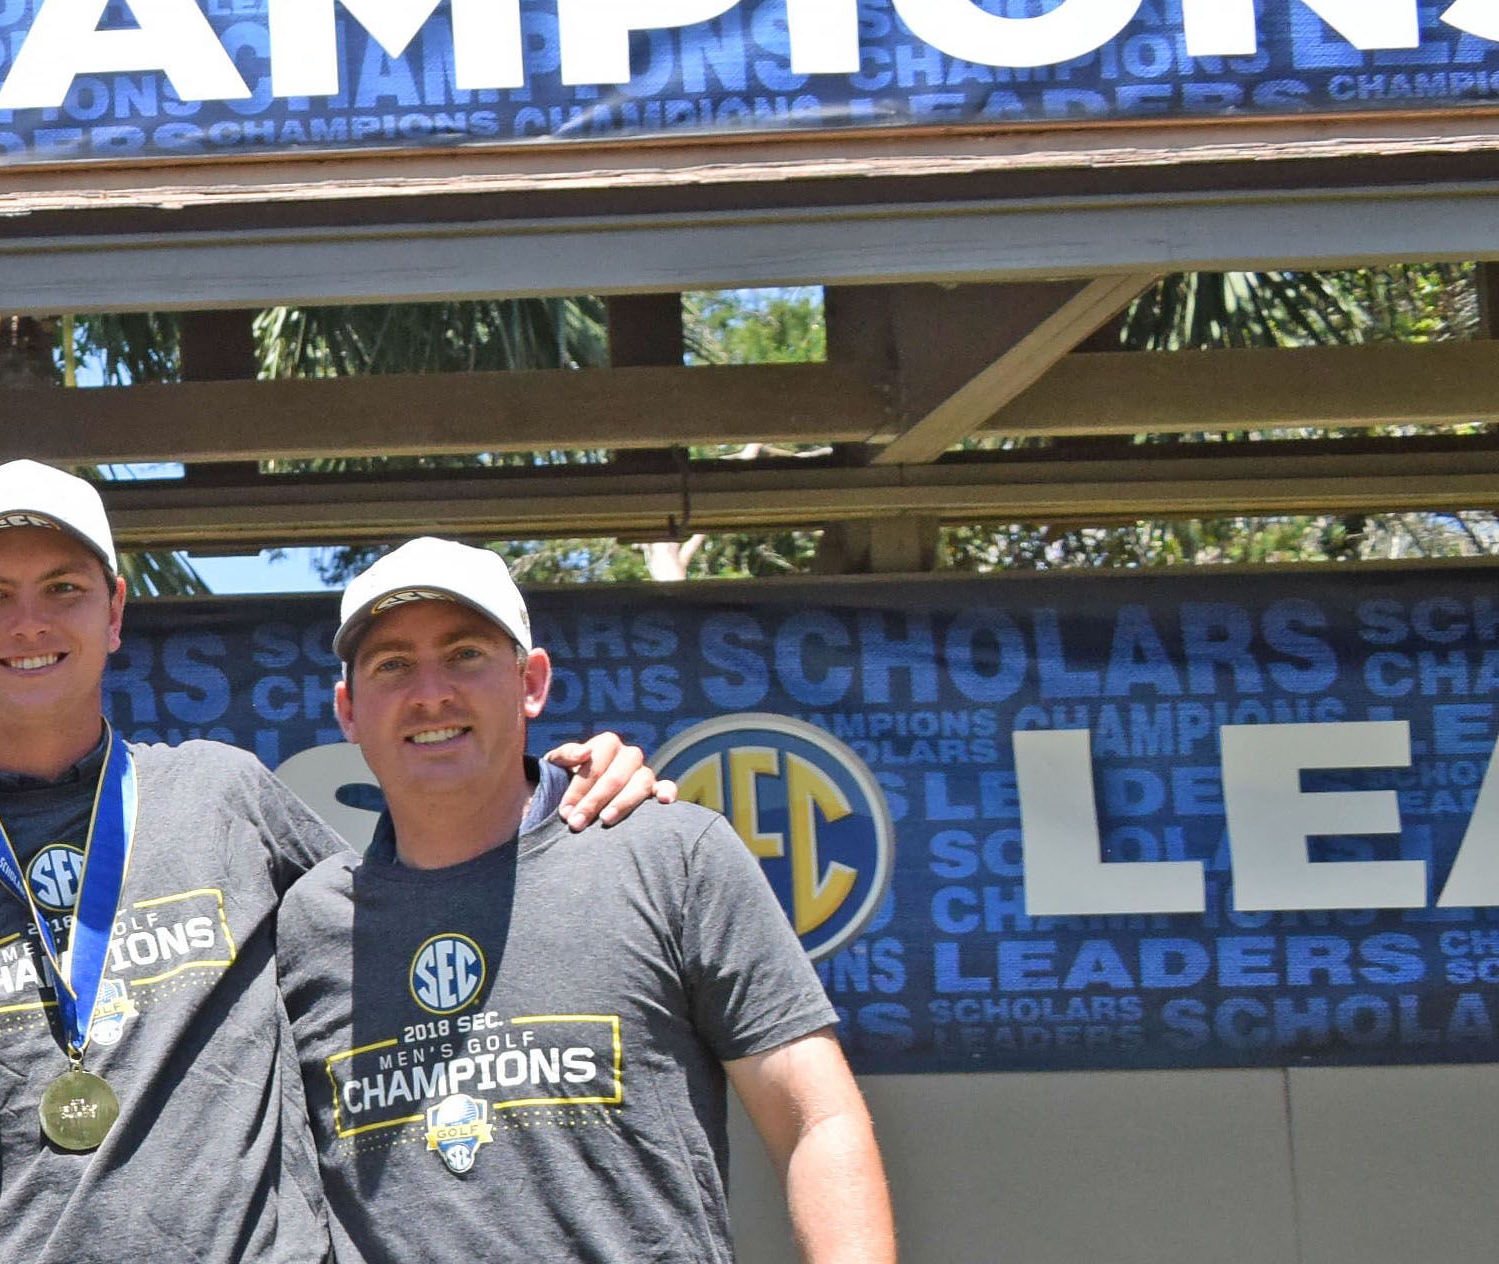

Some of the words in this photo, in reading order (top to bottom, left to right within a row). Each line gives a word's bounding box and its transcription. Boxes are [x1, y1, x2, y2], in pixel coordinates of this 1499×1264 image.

[208, 109, 501, 146] CHAMPIONS
[699, 600, 1341, 706] SCHOLARS
[113, 913, 159, 935] OLF
[415, 939, 478, 1008] SEC
[933, 929, 1429, 995] LEADERS
[404, 1019, 449, 1043] 2018
[457, 1011, 503, 1033] SEC.
[928, 996, 1144, 1026] SCHOLARS
[379, 1042, 453, 1071] MEN'S
[467, 1030, 535, 1053] GOLF
[342, 1047, 596, 1114] CHAMPIONS
[436, 1124, 479, 1139] GOLF
